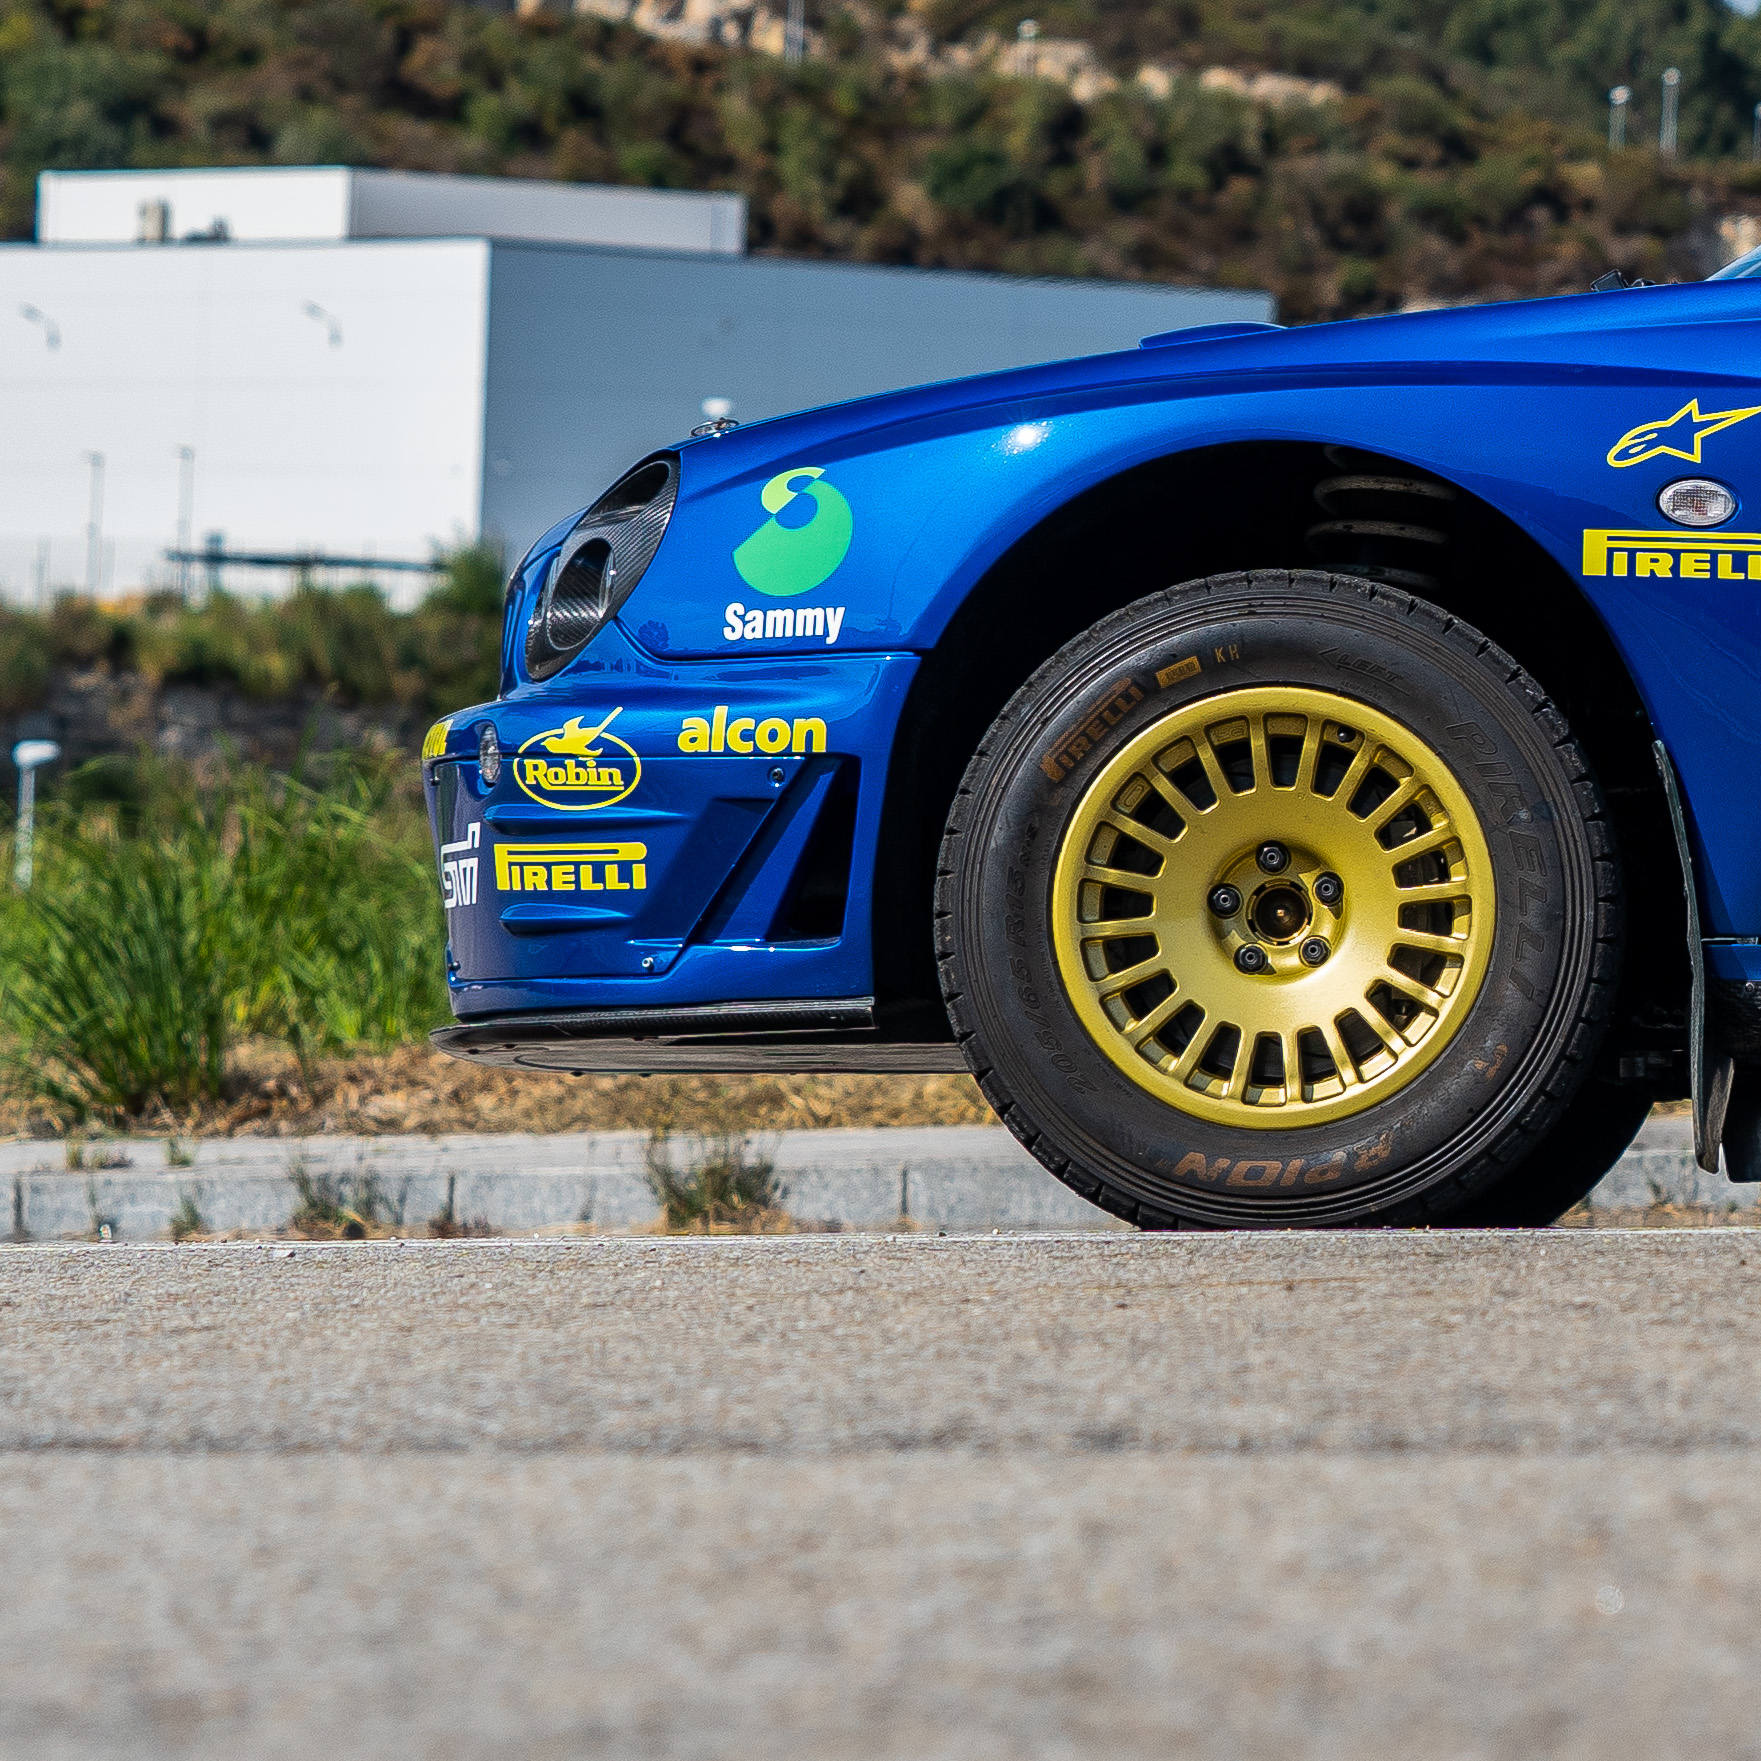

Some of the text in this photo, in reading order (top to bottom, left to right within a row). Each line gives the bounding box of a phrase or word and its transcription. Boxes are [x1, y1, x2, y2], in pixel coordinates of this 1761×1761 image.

[723, 601, 846, 645] Sammy
[676, 705, 827, 754] alcon
[1040, 676, 1145, 784] PIRELLI
[523, 758, 625, 791] Robin
[493, 841, 648, 891] PIRELLI
[1442, 718, 1549, 1005] PIRELLI
[1004, 864, 1026, 948] R15
[1009, 954, 1099, 1095] 205/65
